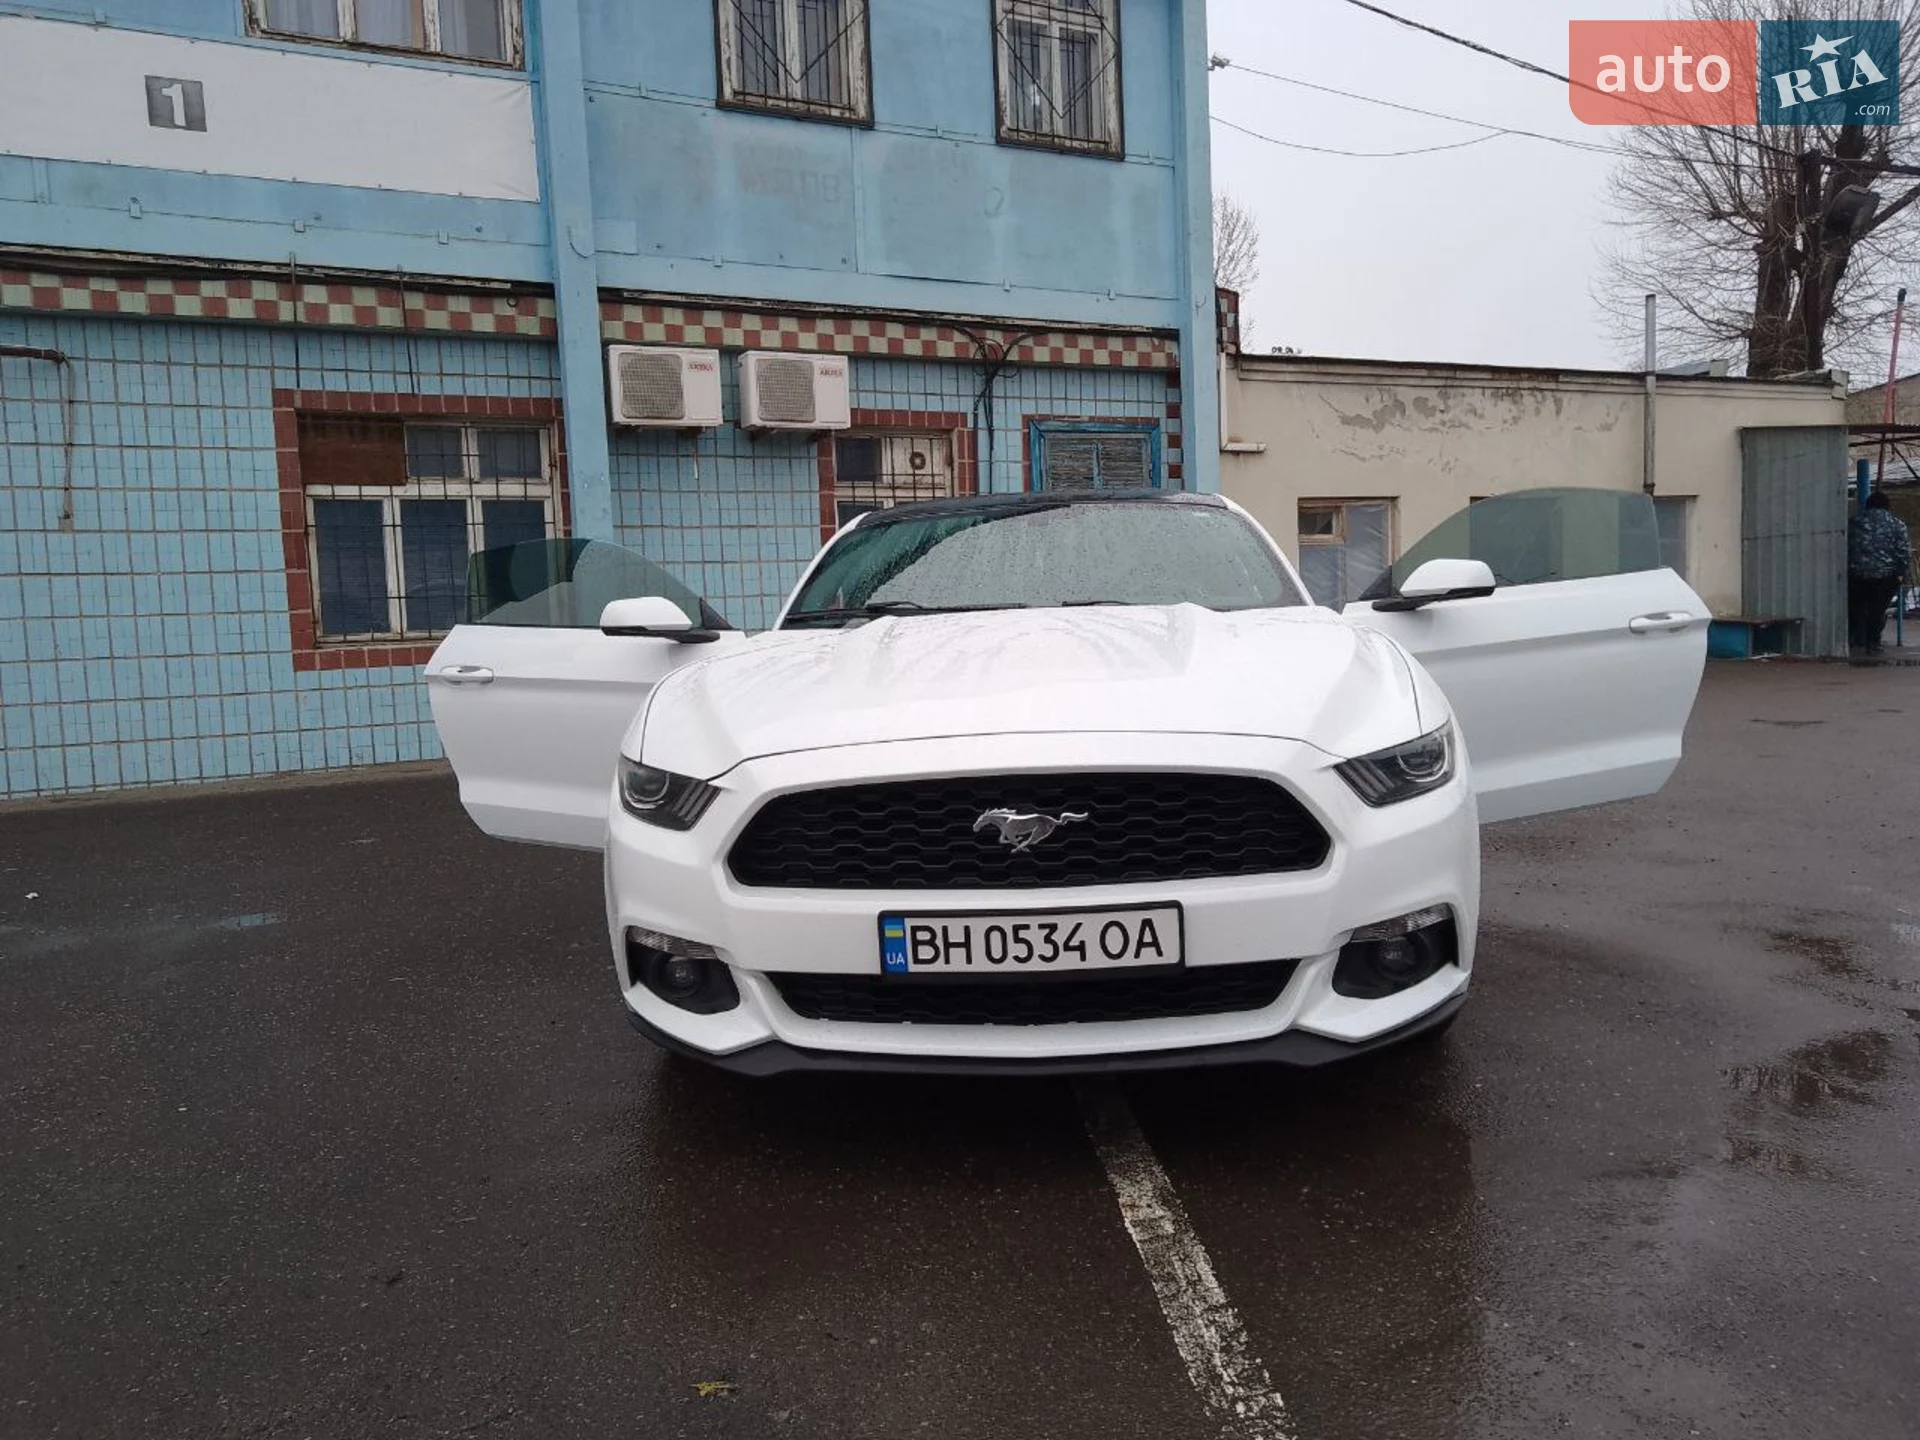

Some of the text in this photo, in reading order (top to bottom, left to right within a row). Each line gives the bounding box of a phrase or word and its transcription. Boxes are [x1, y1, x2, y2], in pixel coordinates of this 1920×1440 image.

[161, 83, 187, 127] 1
[886, 952, 905, 965] UA
[910, 917, 1164, 965] BH 0534 OA
